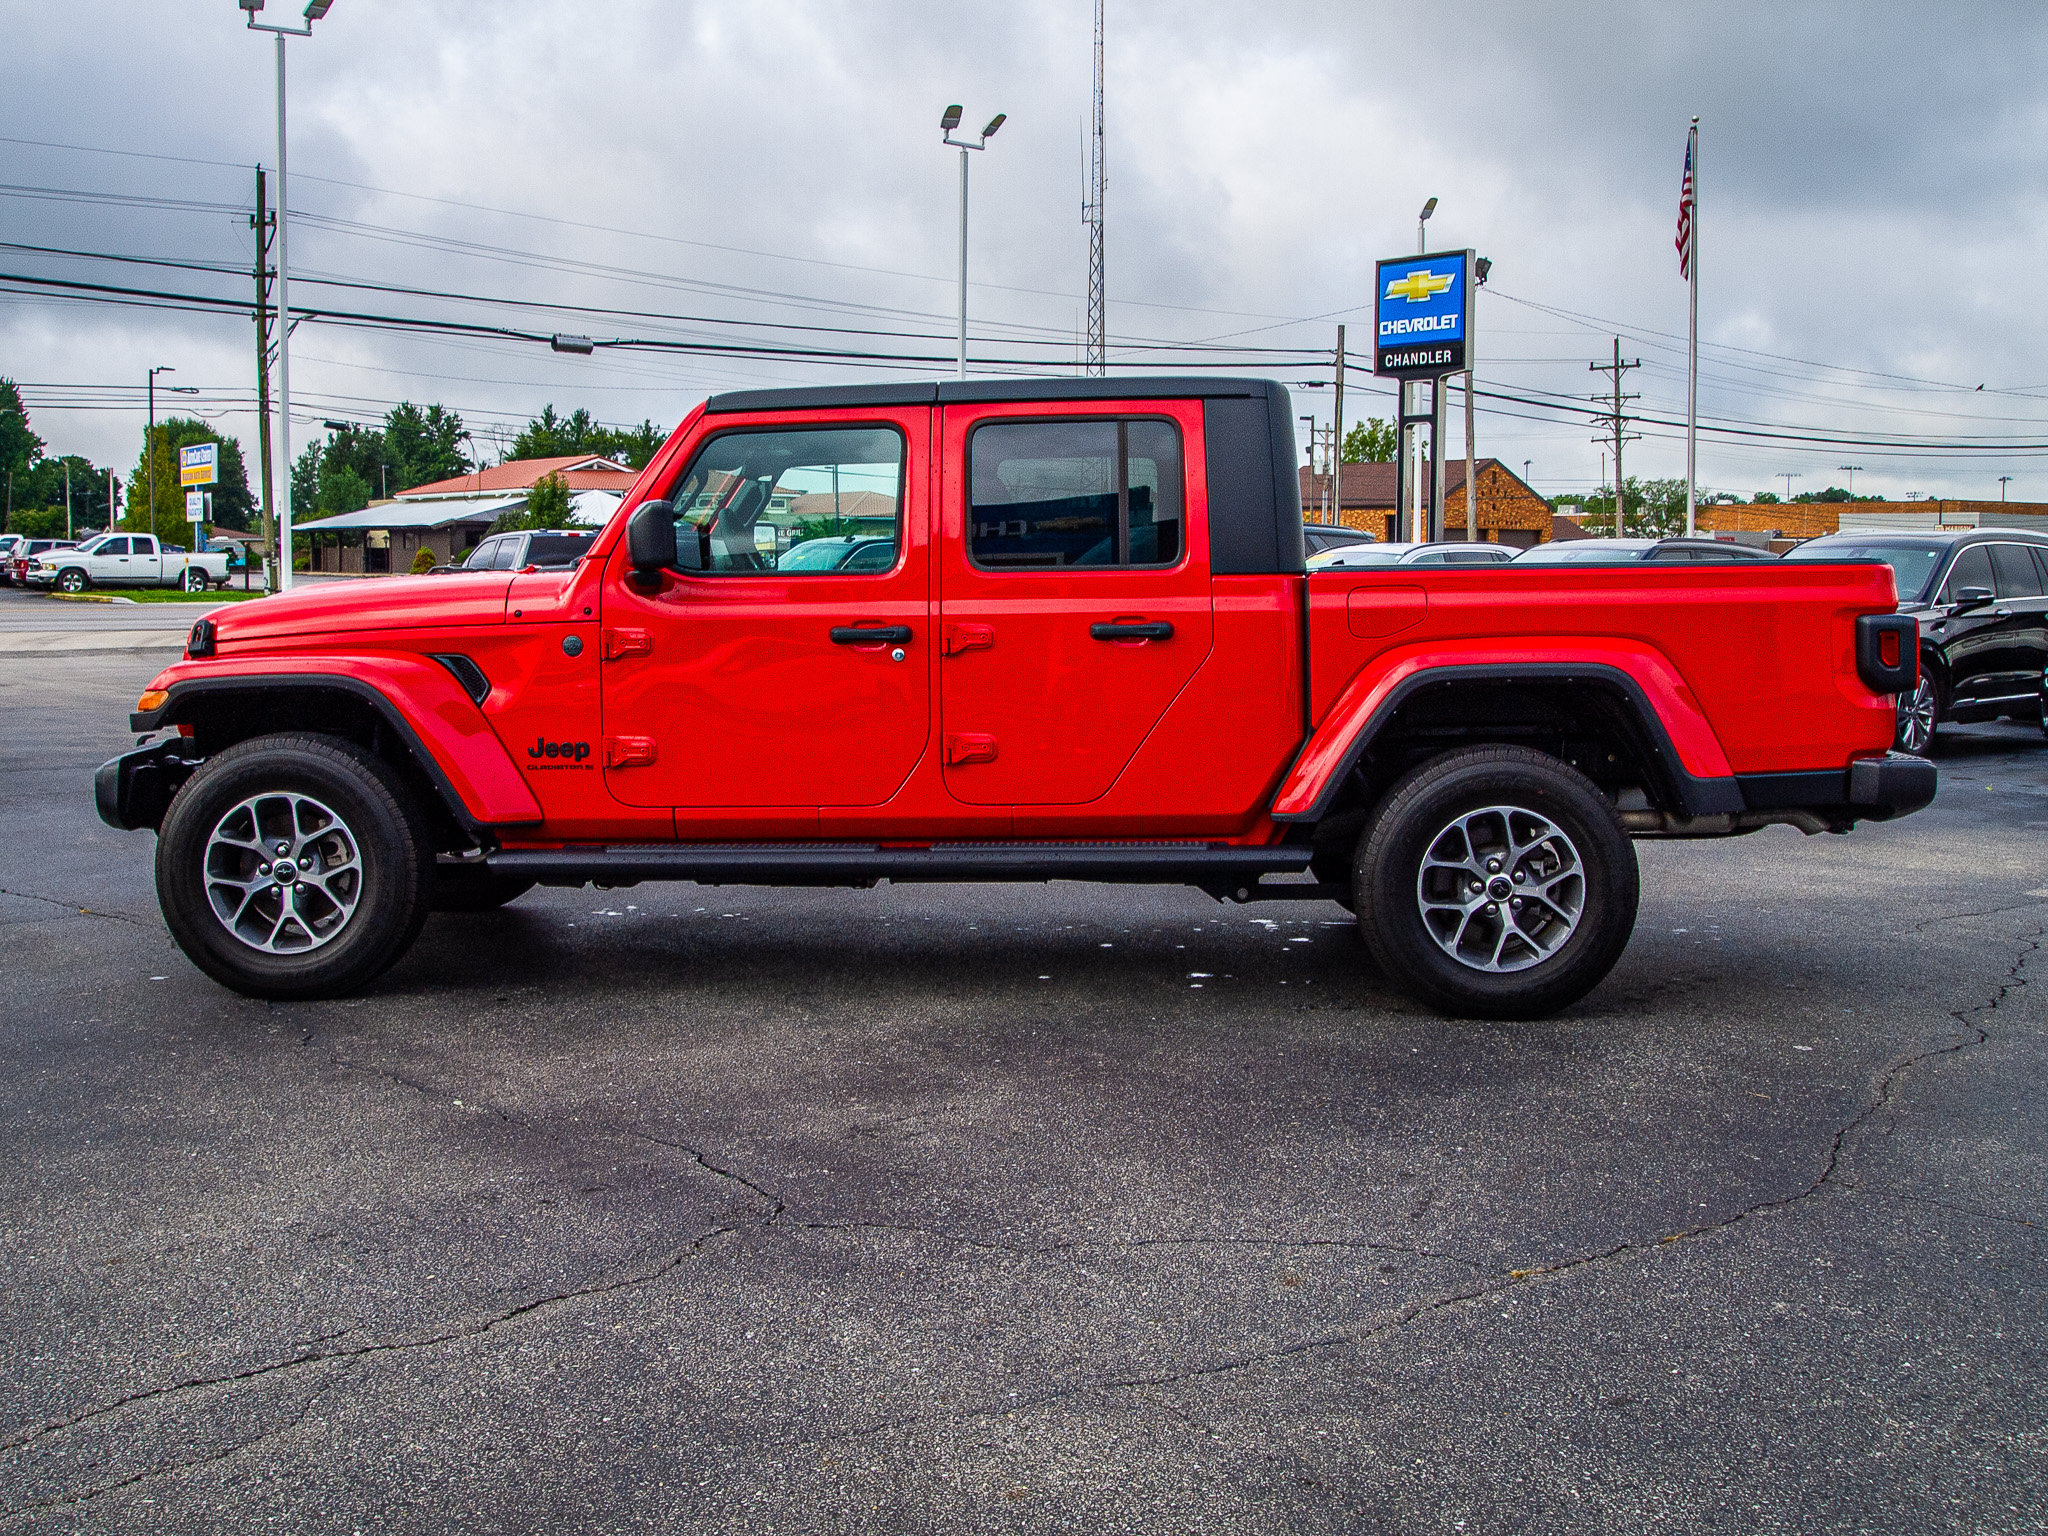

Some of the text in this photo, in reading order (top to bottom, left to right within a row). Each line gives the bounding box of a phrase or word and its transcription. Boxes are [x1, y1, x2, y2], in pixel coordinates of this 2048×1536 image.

[1380, 314, 1459, 335] CHEVROLET
[1385, 350, 1452, 367] CHANDLER
[528, 737, 590, 762] Jeep
